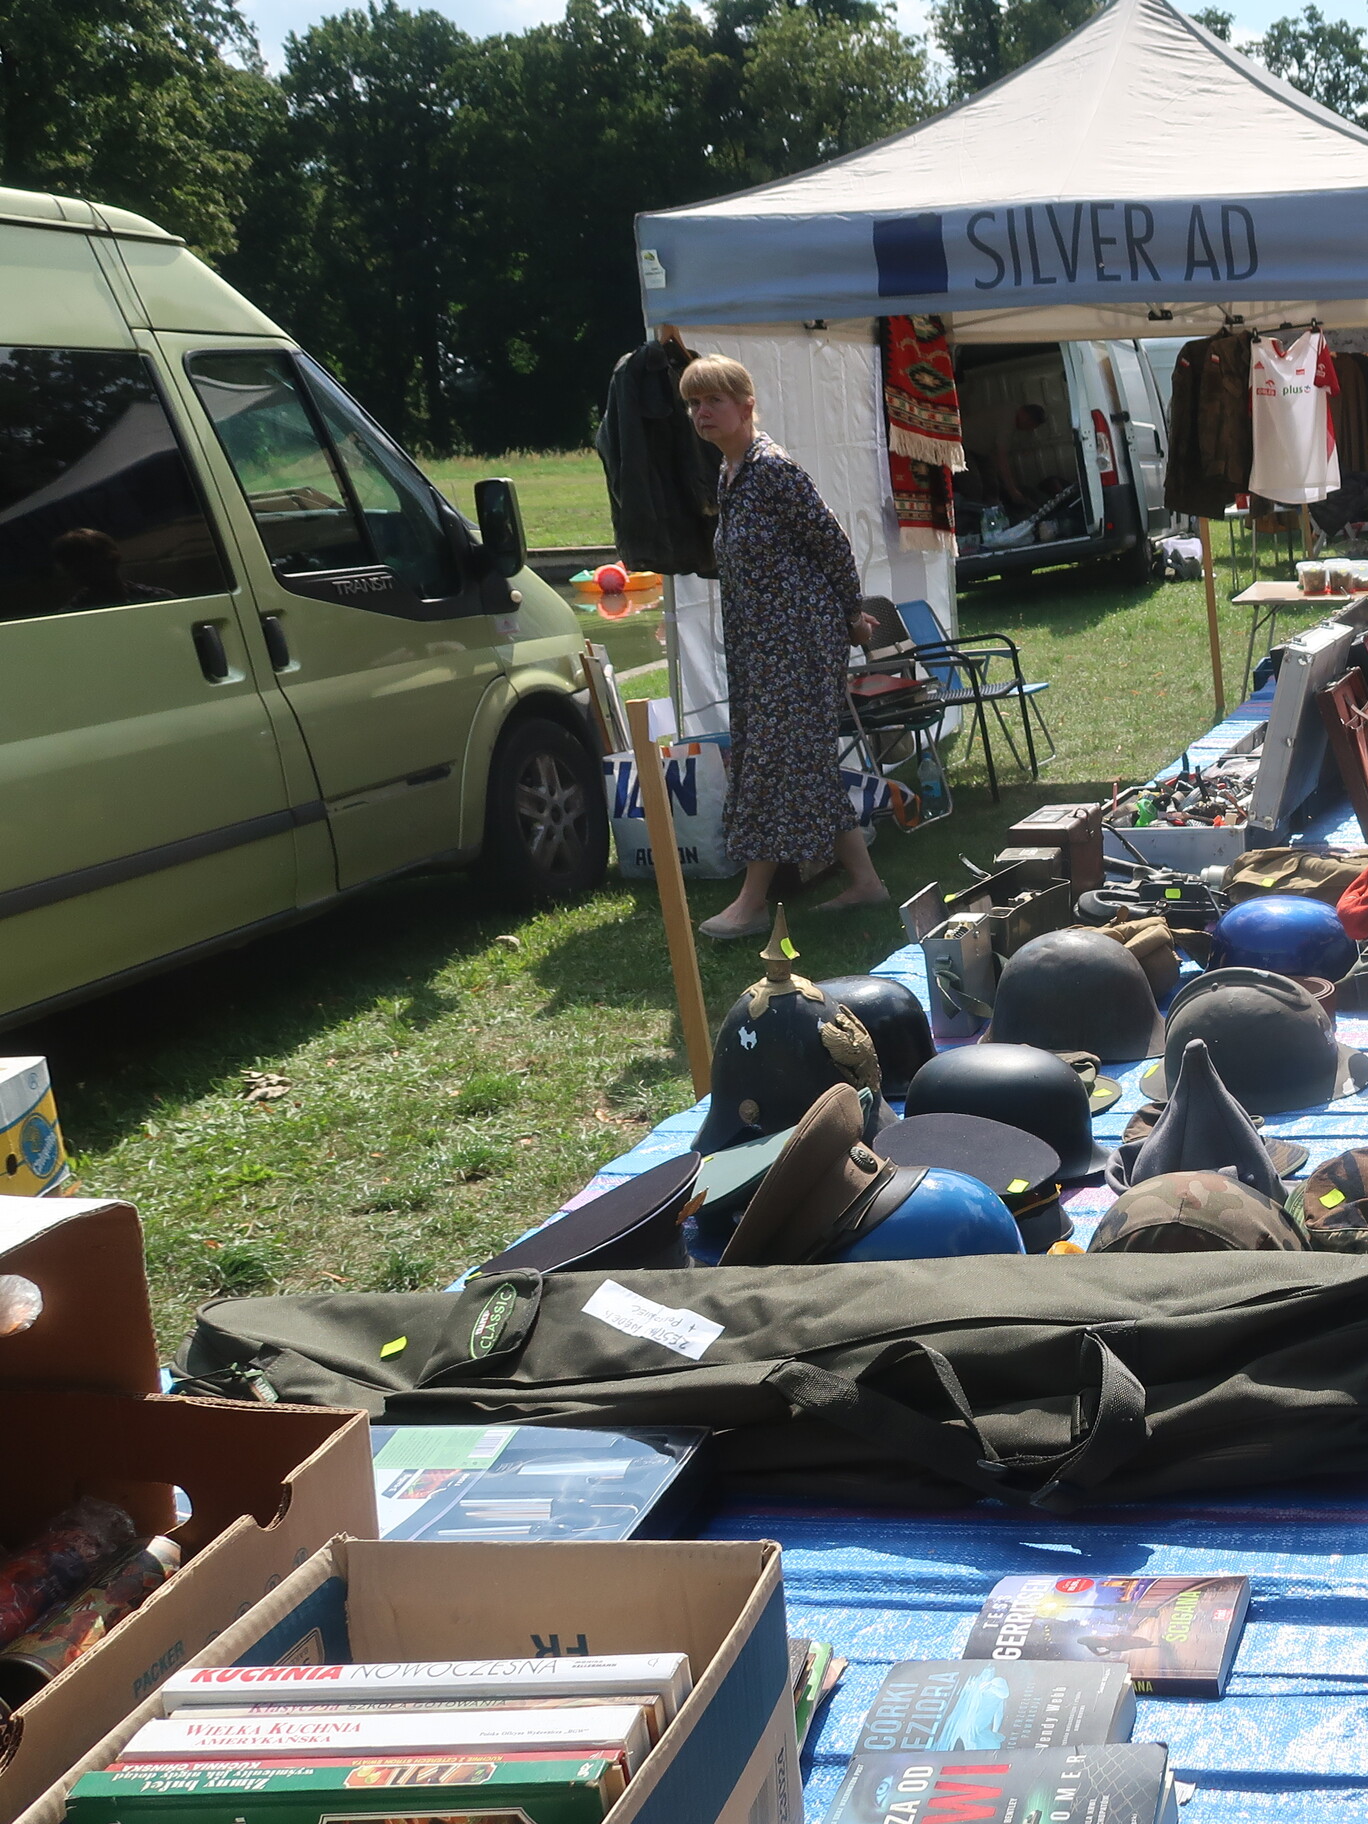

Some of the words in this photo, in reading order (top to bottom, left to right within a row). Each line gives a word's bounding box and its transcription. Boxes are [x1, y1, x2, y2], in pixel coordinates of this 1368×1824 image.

[966, 201, 1162, 291] SILVER
[1184, 203, 1259, 282] AD
[1282, 384, 1304, 397] plus
[332, 575, 393, 595] TRANSIT
[479, 1290, 512, 1350] CLASSIC
[983, 1594, 1012, 1630] TESS
[991, 1579, 1051, 1661] GERRITSEN
[1165, 1590, 1202, 1643] ŚCIGANA
[530, 1633, 590, 1659] FR
[133, 1640, 185, 1699] PACKER
[190, 1665, 345, 1684] KUCHNIA
[351, 1659, 558, 1679] NOWOCZESNA
[1052, 1684, 1067, 1713] Webb
[186, 1723, 262, 1737] WIELKA
[267, 1721, 363, 1736] KUCHNIA
[864, 1682, 919, 1750] CÓRKI
[195, 1734, 331, 1746] AMERYKAŃSKA
[159, 1769, 201, 1781] nigdy
[192, 1761, 262, 1770] KUCHNIA
[140, 1780, 199, 1793] bufet
[202, 1777, 270, 1791] Zimny
[1003, 1797, 1018, 1824] BENTLEY
